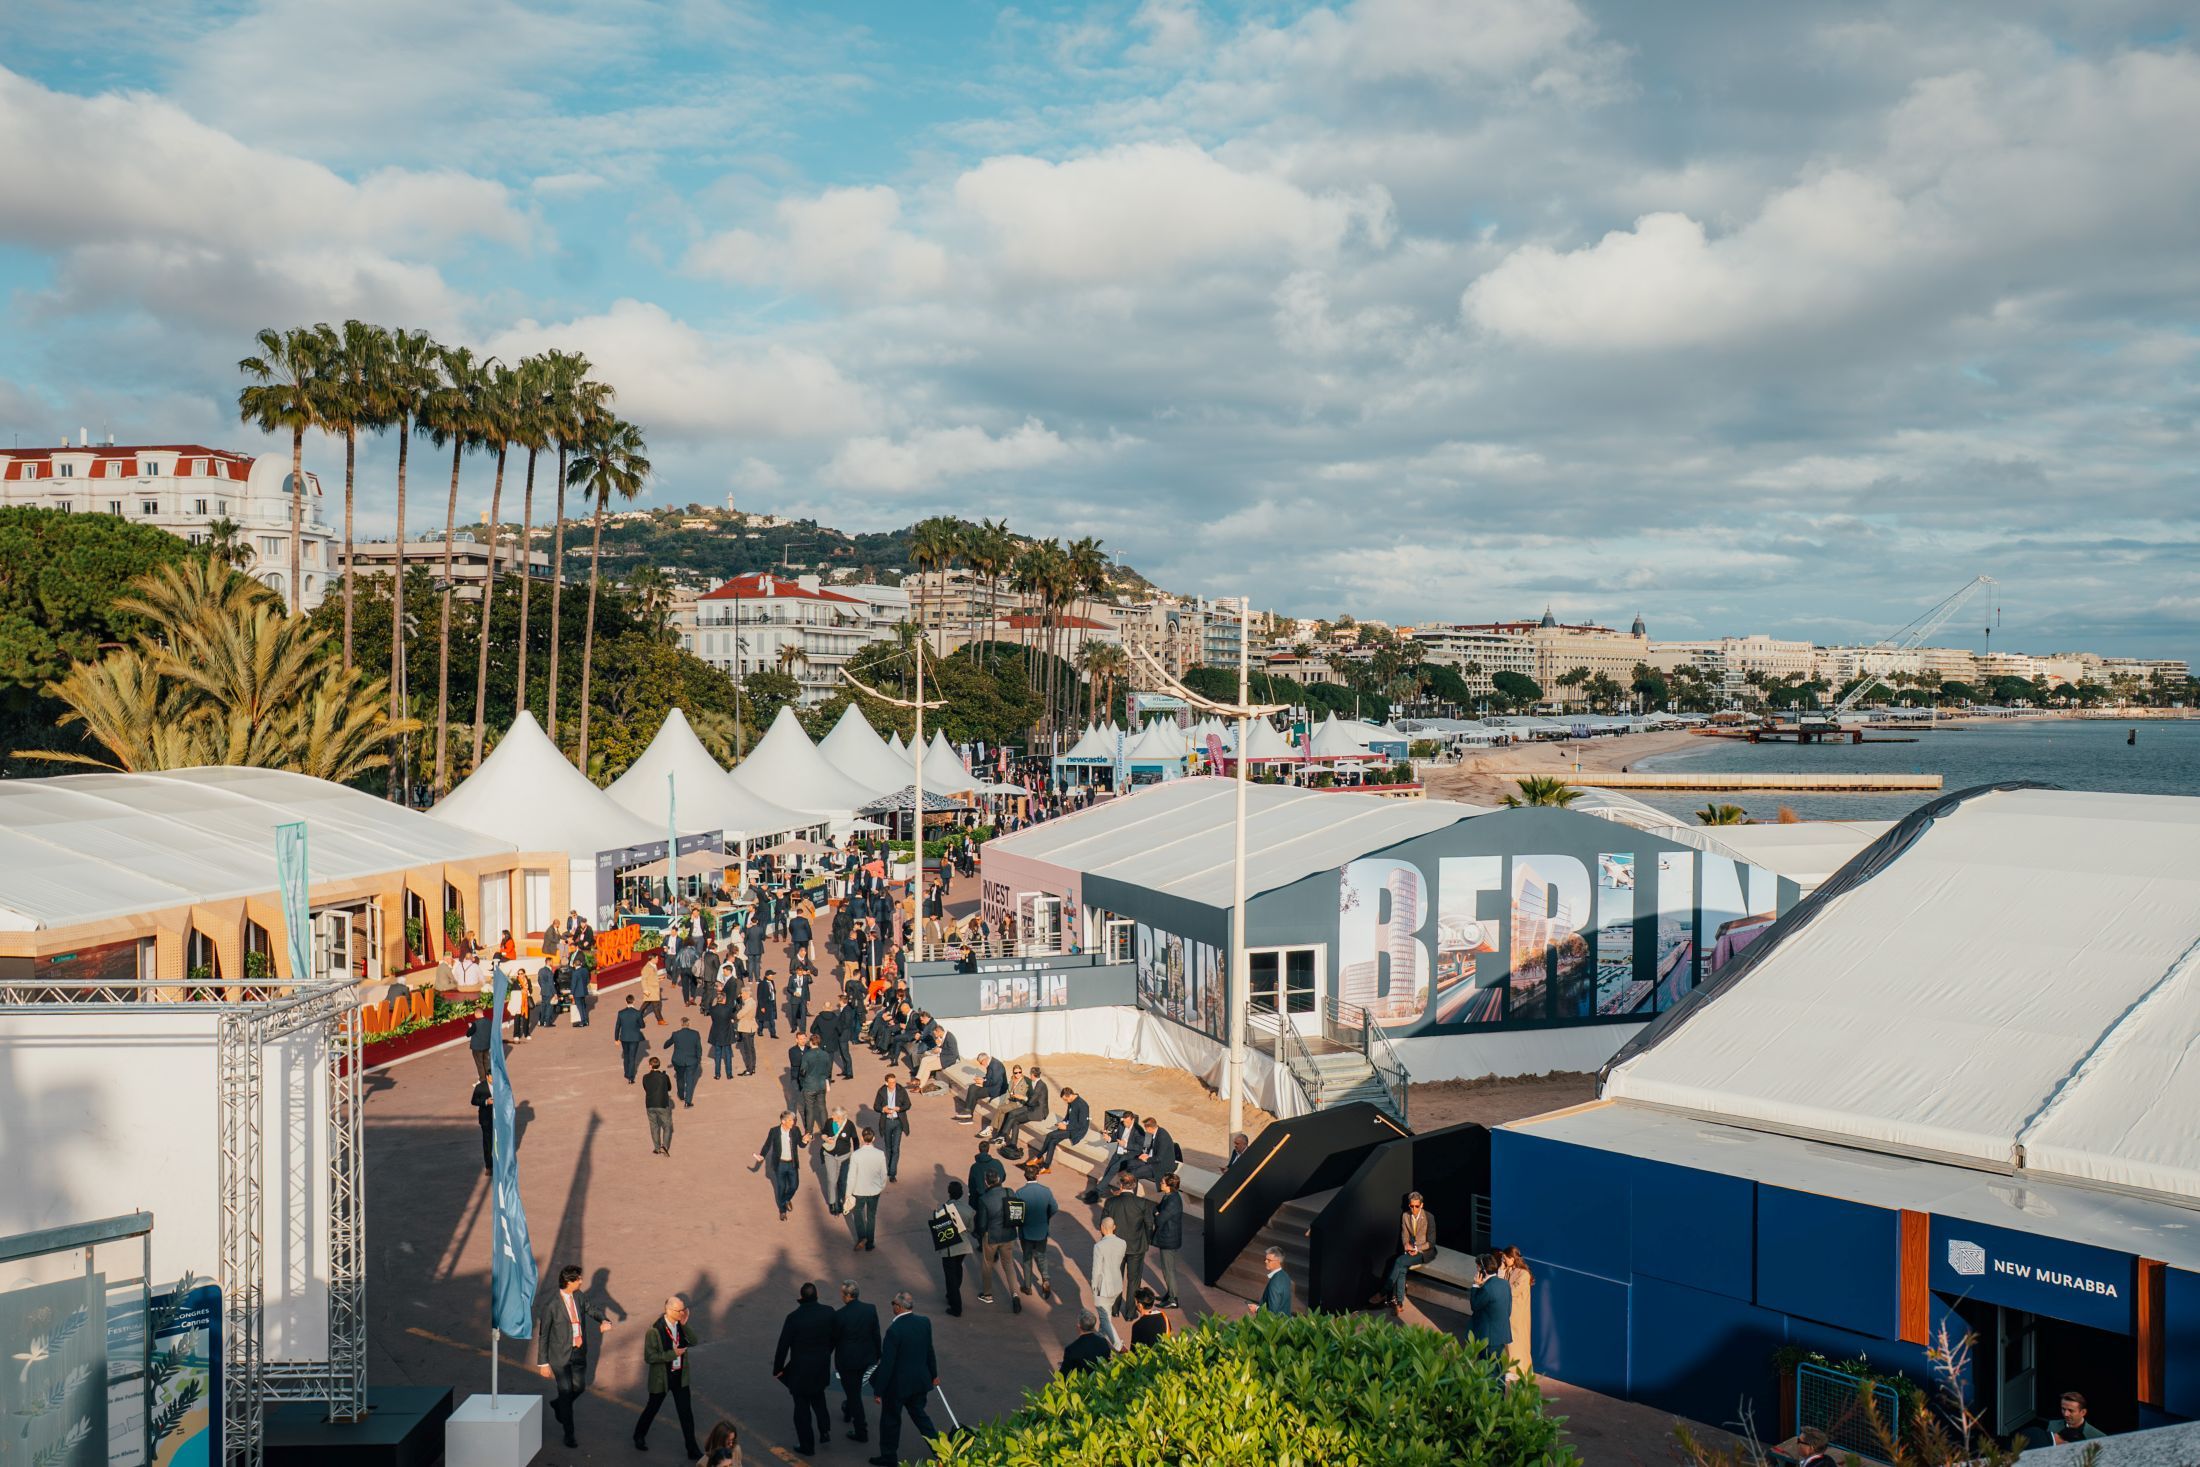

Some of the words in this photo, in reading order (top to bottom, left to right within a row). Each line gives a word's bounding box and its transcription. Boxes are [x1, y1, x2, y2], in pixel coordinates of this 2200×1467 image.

[1067, 754, 1107, 763] newcastle
[983, 879, 1010, 907] INVEST
[1339, 851, 1777, 1028] BERLIN
[980, 974, 1068, 1011] BERLIN
[1137, 922, 1225, 1041] BERLIN
[1994, 1259, 2031, 1278] NEW
[2036, 1268, 2118, 1298] MURABBA
[181, 1317, 210, 1328] Cannes
